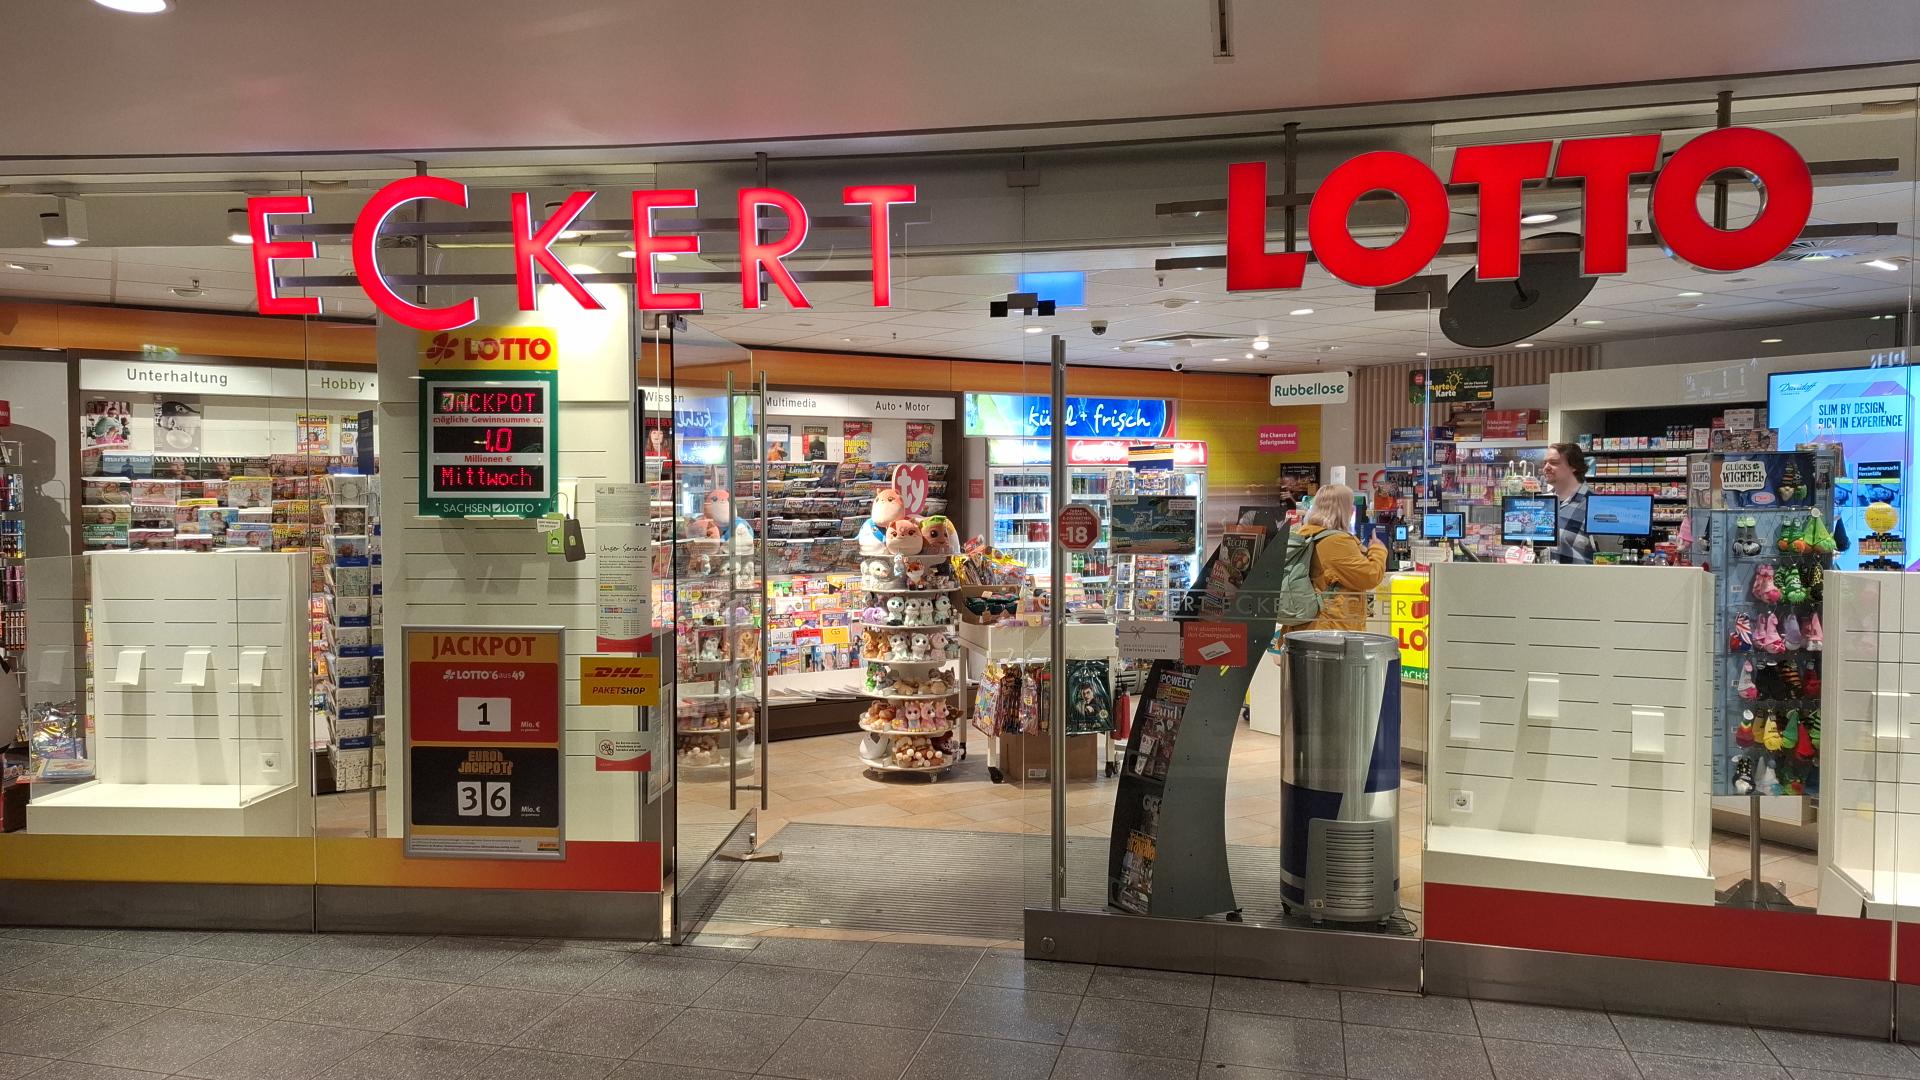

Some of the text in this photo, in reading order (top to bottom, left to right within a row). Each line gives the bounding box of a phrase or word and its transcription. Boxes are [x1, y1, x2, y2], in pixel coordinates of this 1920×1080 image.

[1227, 127, 1813, 291] LOTTO
[248, 175, 917, 331] ECKERT
[464, 337, 551, 360] LOTTO
[127, 368, 228, 386] Unterhaltung
[321, 377, 365, 392] Hobby
[1274, 383, 1344, 396] Rubbellose
[442, 392, 536, 412] JACKPOT
[645, 391, 685, 403] Wissen
[765, 397, 817, 409] Multimedia
[876, 400, 930, 412] Auto Motor
[1818, 402, 1887, 416] SLIM BY DESIGN,
[433, 416, 469, 425] mögliche
[471, 415, 531, 424] Gewinnsumme
[1029, 403, 1077, 426] kül
[1093, 405, 1150, 432] frisch
[1840, 418, 1848, 428] IN
[1851, 415, 1904, 427] EXPERIENCE
[486, 428, 513, 452] 1,0
[442, 467, 532, 486] Mittwoch
[1723, 471, 1763, 483] WICHTEL
[898, 469, 924, 513] ty
[444, 503, 534, 513] SACHSEN LOTTO
[1065, 527, 1088, 543] 18
[623, 544, 648, 552] Service
[432, 636, 536, 660] JACKPOT
[457, 671, 489, 680] LOTTO
[594, 667, 644, 678] DHL
[592, 686, 646, 695] PAKETSHOP
[477, 702, 491, 726] 1
